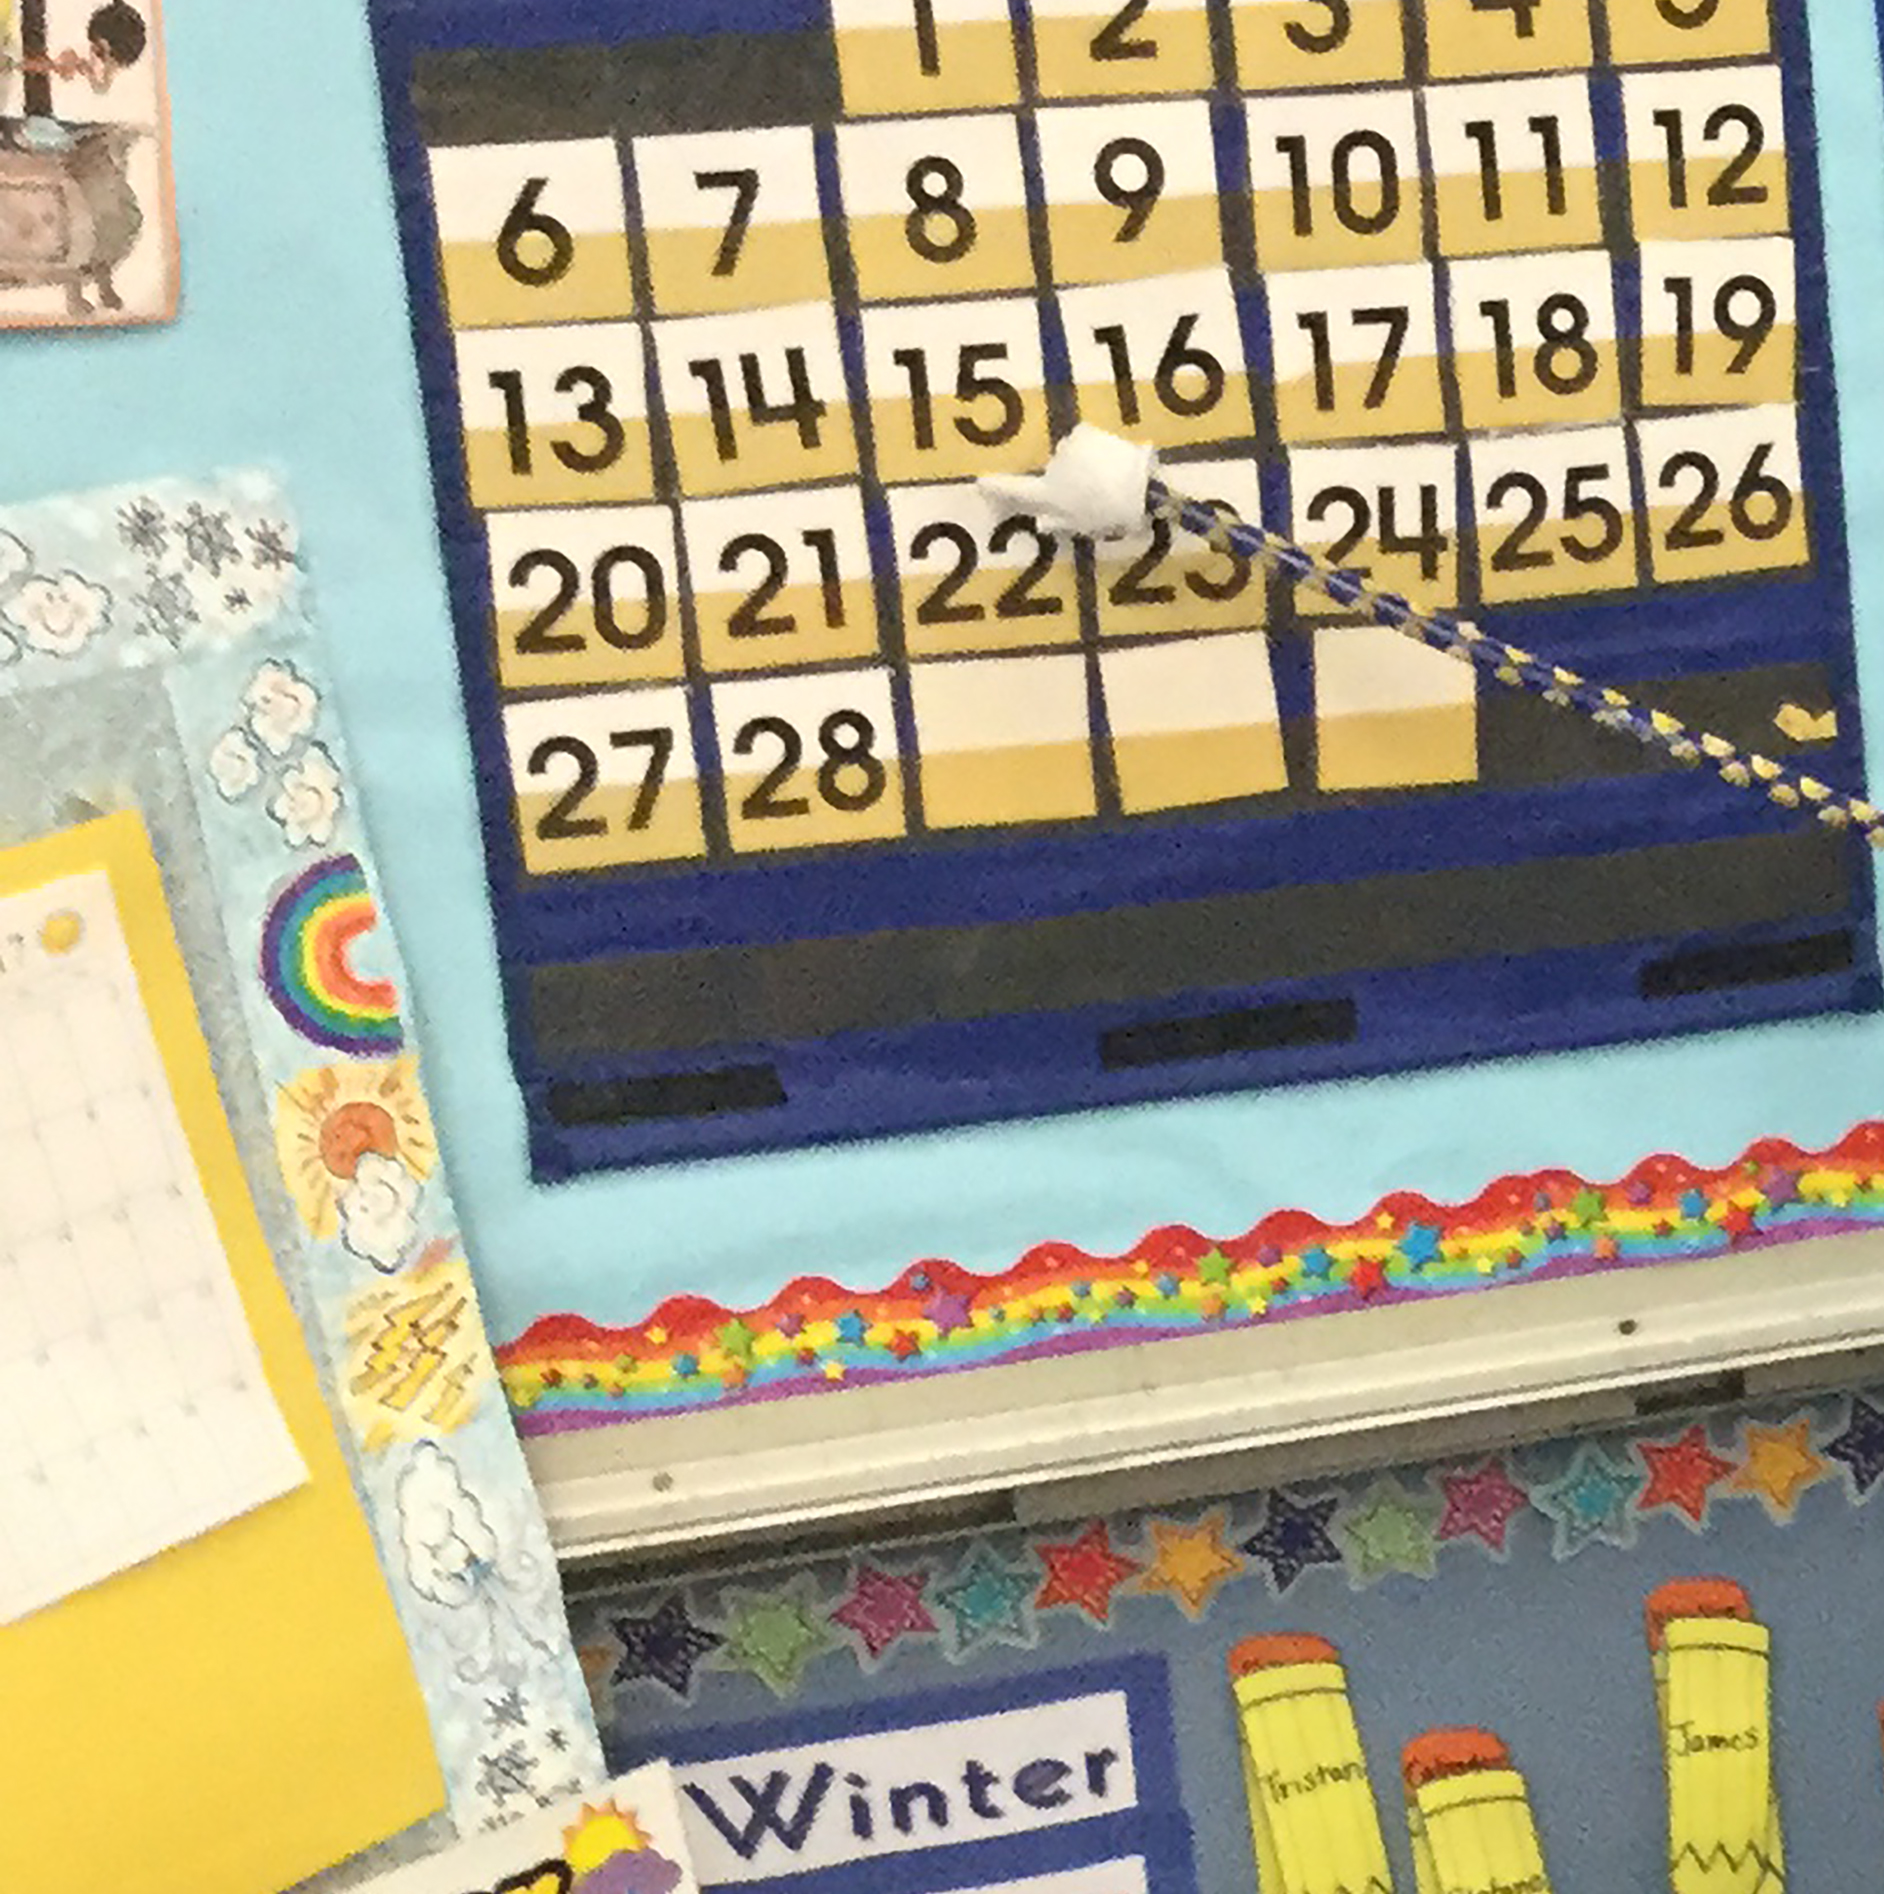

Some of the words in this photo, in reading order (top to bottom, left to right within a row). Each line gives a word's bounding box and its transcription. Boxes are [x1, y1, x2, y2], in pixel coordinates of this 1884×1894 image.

[904, 156, 977, 264] 8
[1092, 136, 1166, 244] 9
[1275, 129, 1400, 237] 10
[1464, 114, 1567, 222] 11
[1652, 103, 1769, 210] 12
[497, 177, 575, 288] 6
[694, 169, 760, 277] 7
[1092, 314, 1225, 426] 16
[1296, 306, 1410, 412] 17
[1479, 292, 1598, 399] 18
[1664, 273, 1777, 377] 19
[490, 367, 627, 475] 13
[689, 347, 826, 461] 14
[893, 343, 1024, 450] 15
[1307, 483, 1449, 582] 24
[1486, 462, 1623, 573] 25
[1656, 441, 1793, 554] 26
[507, 544, 666, 657] 20
[716, 528, 847, 640] 21
[908, 514, 1062, 624] 22
[525, 728, 675, 841] 27
[731, 708, 888, 822] 28
[1259, 1761, 1367, 1803] Tristan
[1668, 1720, 1758, 1756] James
[682, 1747, 1118, 1860] Winter
